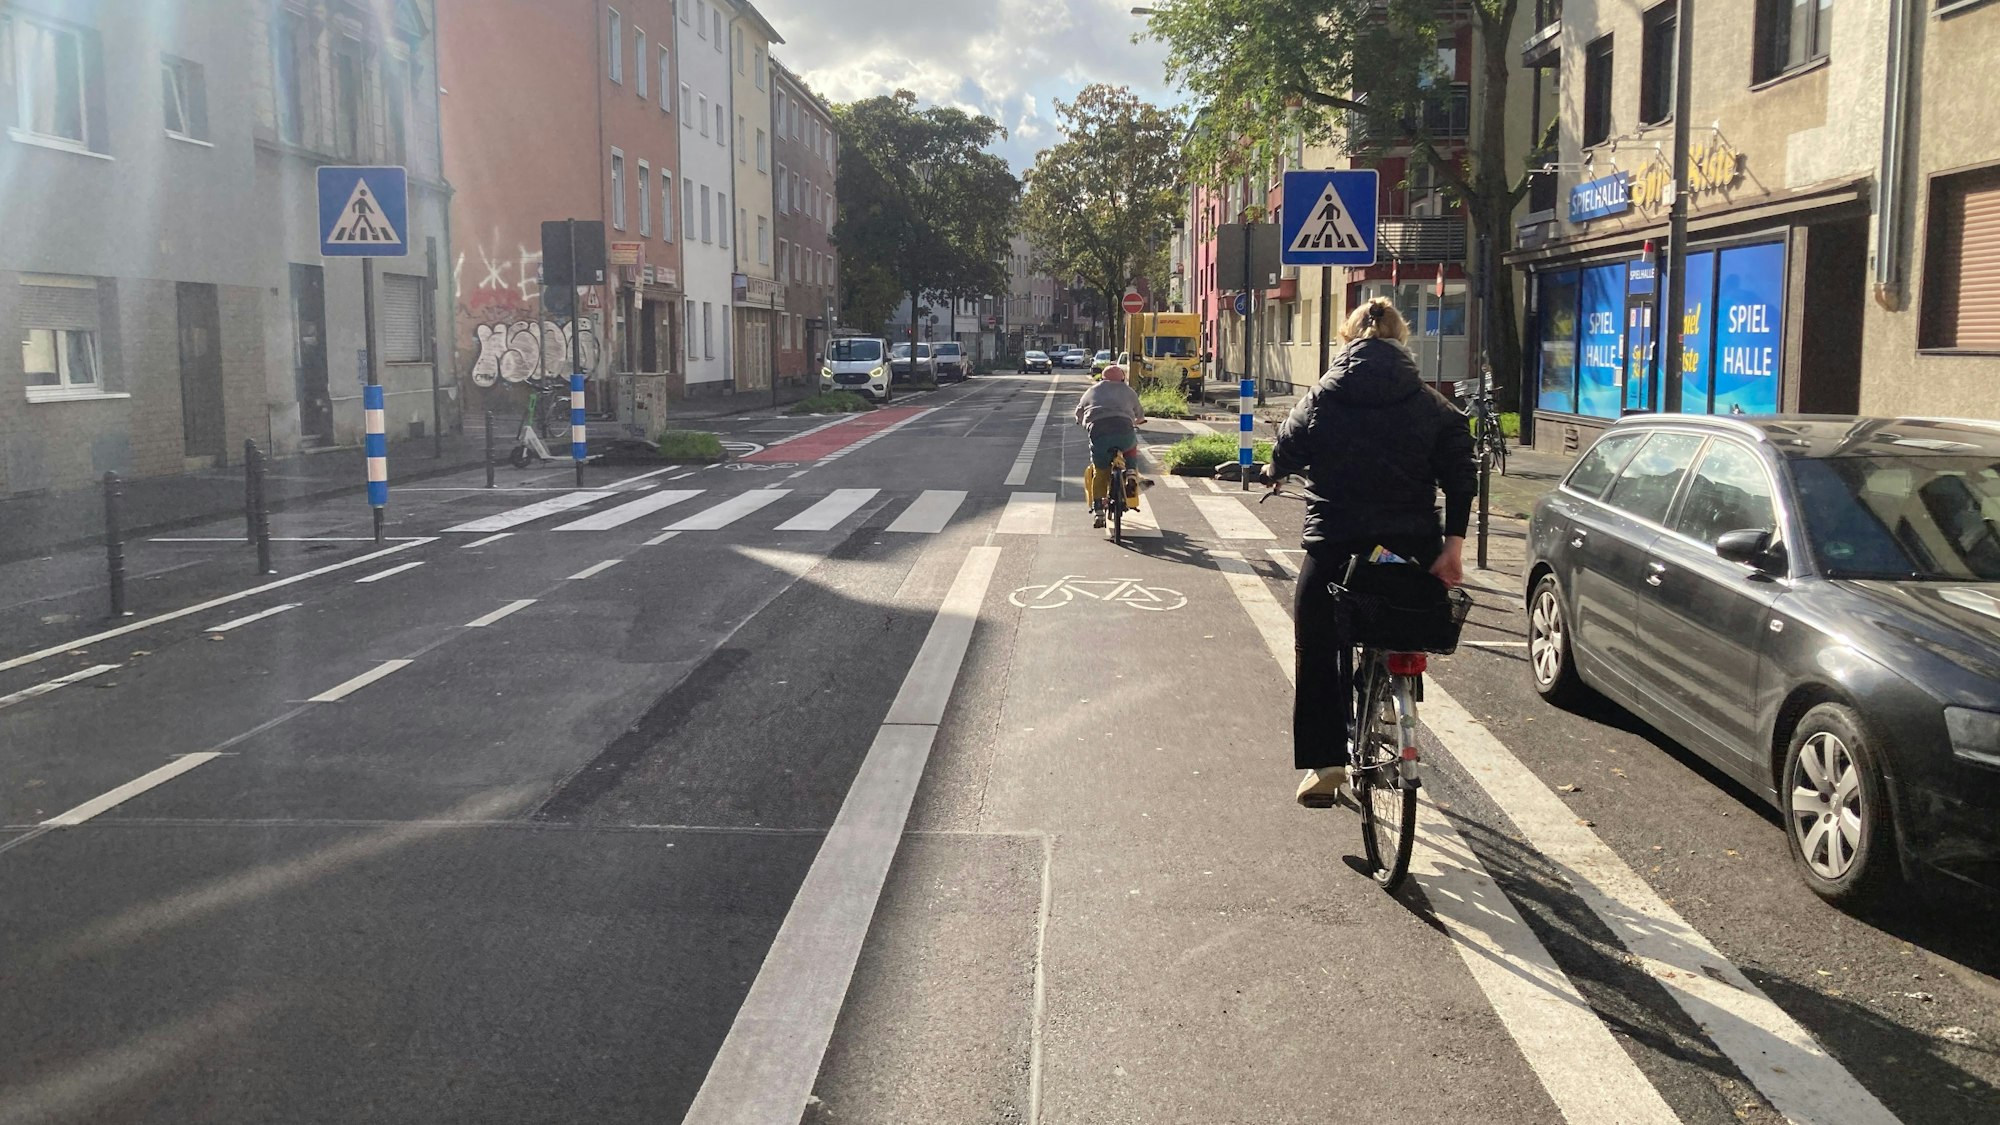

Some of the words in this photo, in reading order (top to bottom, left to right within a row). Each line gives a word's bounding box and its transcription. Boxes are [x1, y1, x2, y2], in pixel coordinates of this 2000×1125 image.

[1571, 180, 1625, 215] SPIELHALLE
[1630, 268, 1655, 280] SPIELHALLE
[1589, 312, 1615, 335] SPIEL
[1728, 304, 1770, 333] SPIEL
[1585, 345, 1616, 368] HALLE
[1683, 346, 1699, 373] iste
[1723, 347, 1772, 376] HALLE
